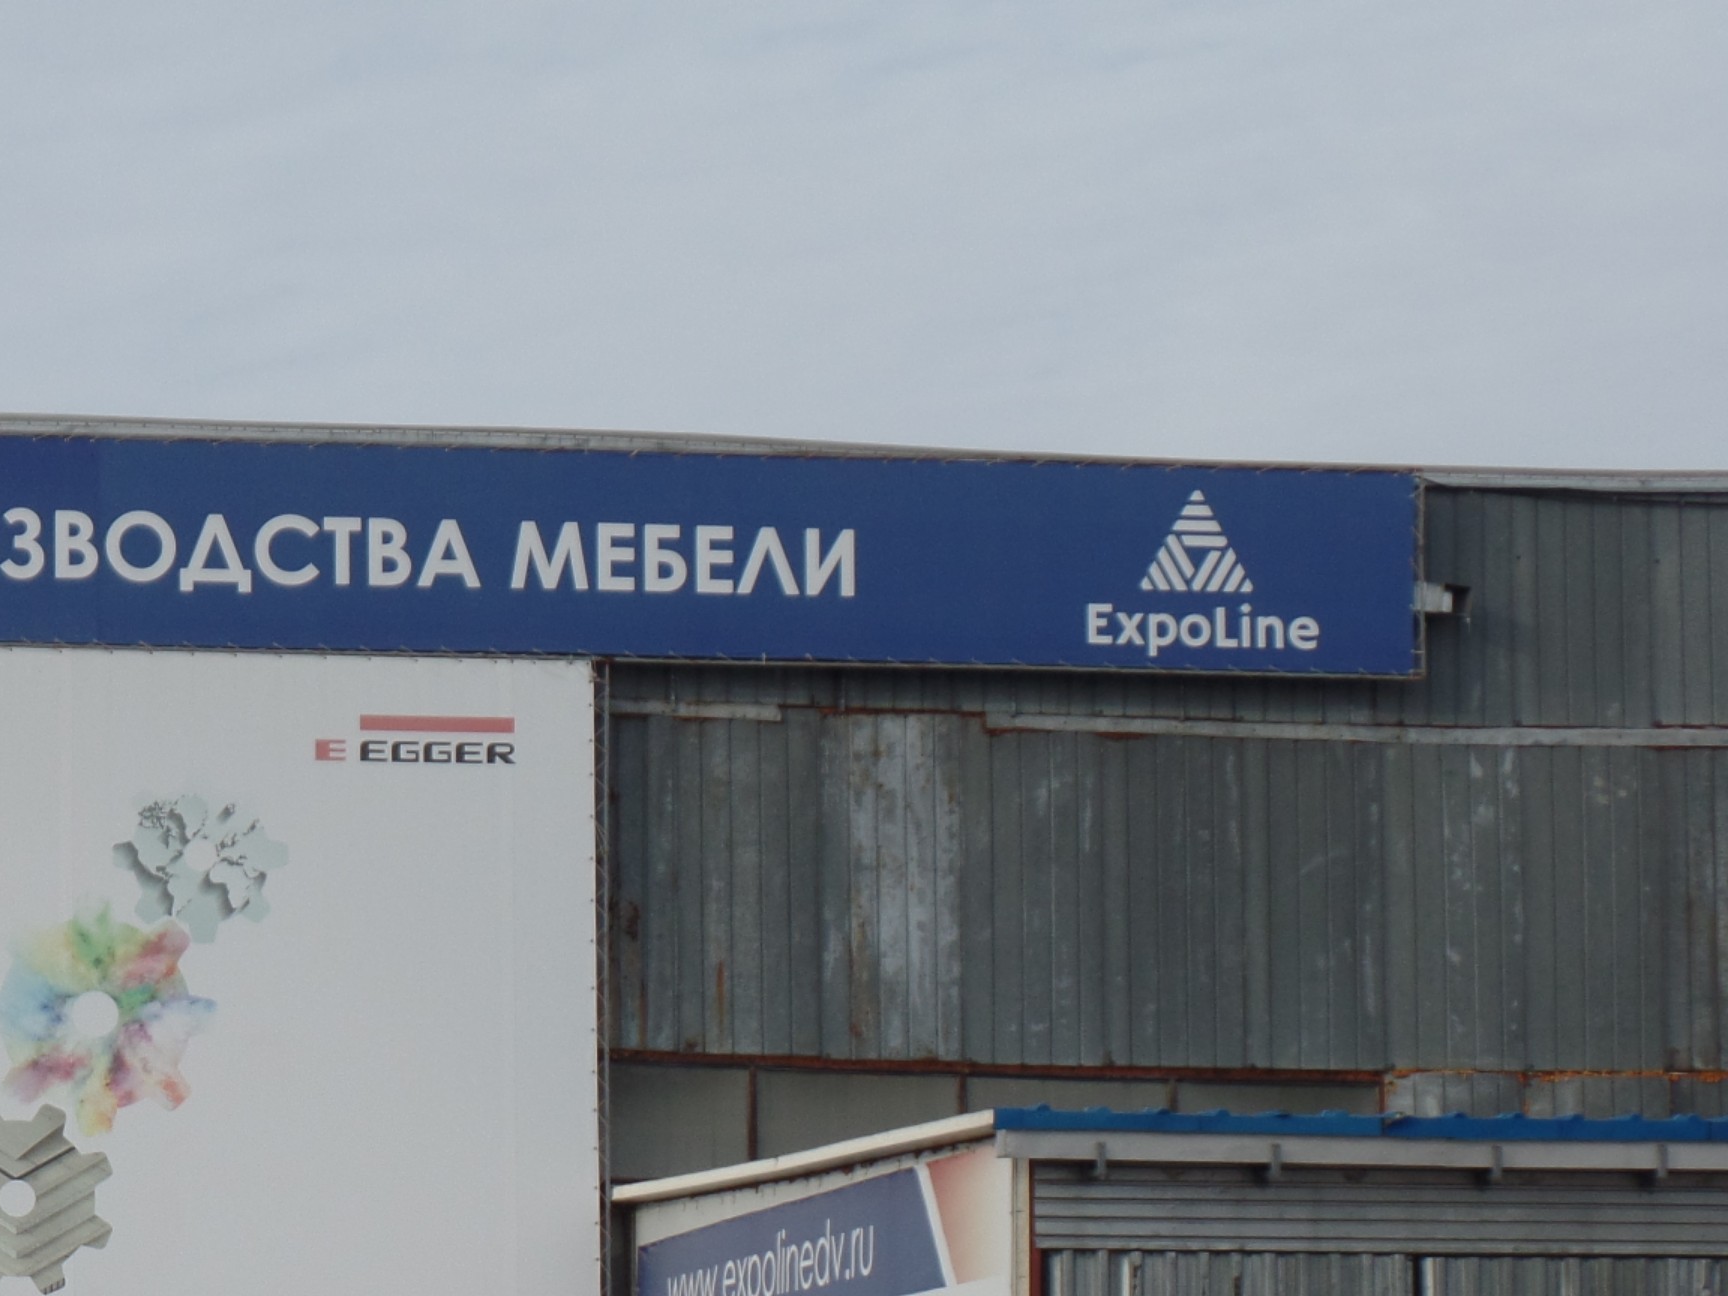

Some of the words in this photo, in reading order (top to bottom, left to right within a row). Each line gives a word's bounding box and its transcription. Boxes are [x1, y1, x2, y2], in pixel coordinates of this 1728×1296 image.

[509, 519, 856, 598] МЕБЕЛИ
[1086, 602, 1321, 658] ExpoLine
[358, 739, 516, 766] EGGER
